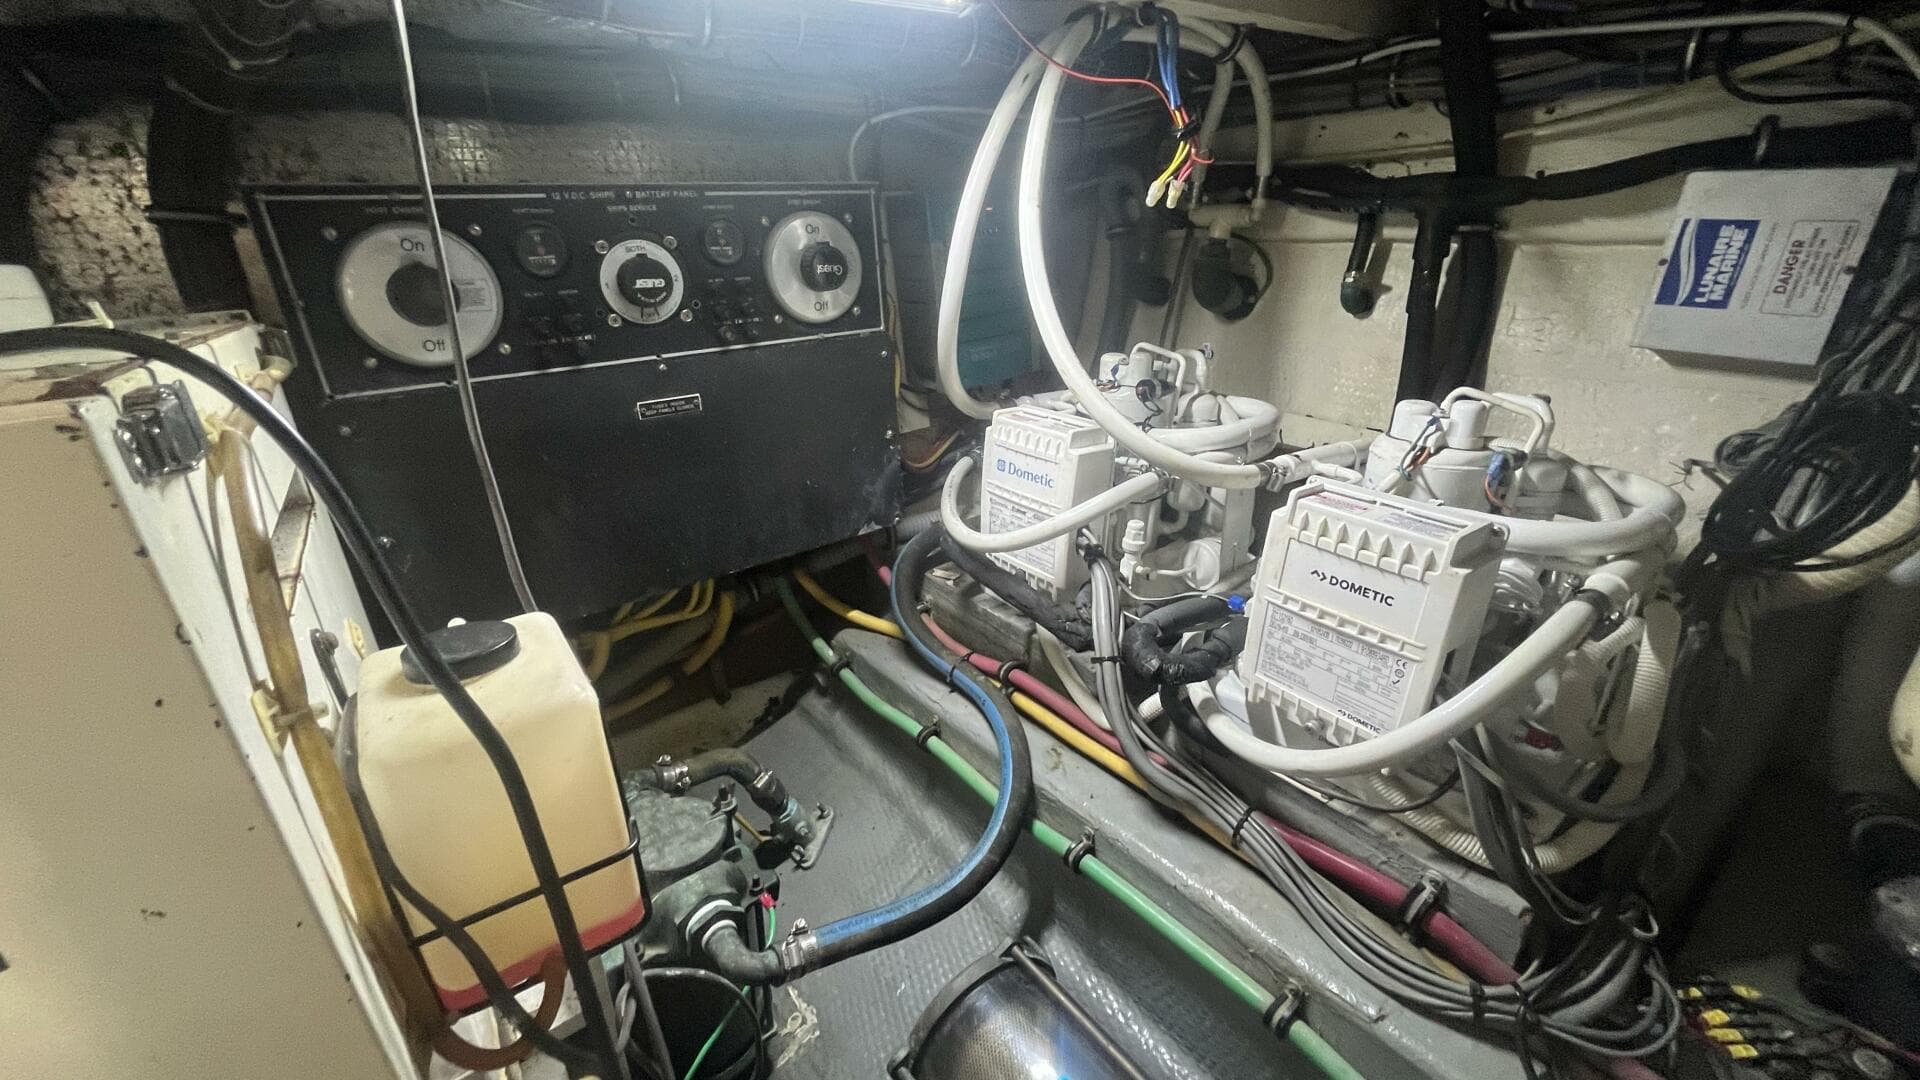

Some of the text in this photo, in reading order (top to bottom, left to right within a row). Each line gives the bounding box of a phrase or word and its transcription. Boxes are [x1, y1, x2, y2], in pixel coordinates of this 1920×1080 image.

[805, 223, 820, 234] On
[400, 238, 425, 252] On
[1694, 223, 1735, 304] LUNAIRE
[1706, 227, 1749, 302] MARINE
[1772, 239, 1806, 295] DANGER
[814, 301, 829, 312] Off
[422, 339, 445, 352] Off
[1008, 461, 1055, 489] Dometic
[1329, 574, 1395, 607] DOMETIC
[1346, 713, 1382, 734] DOMETIC
